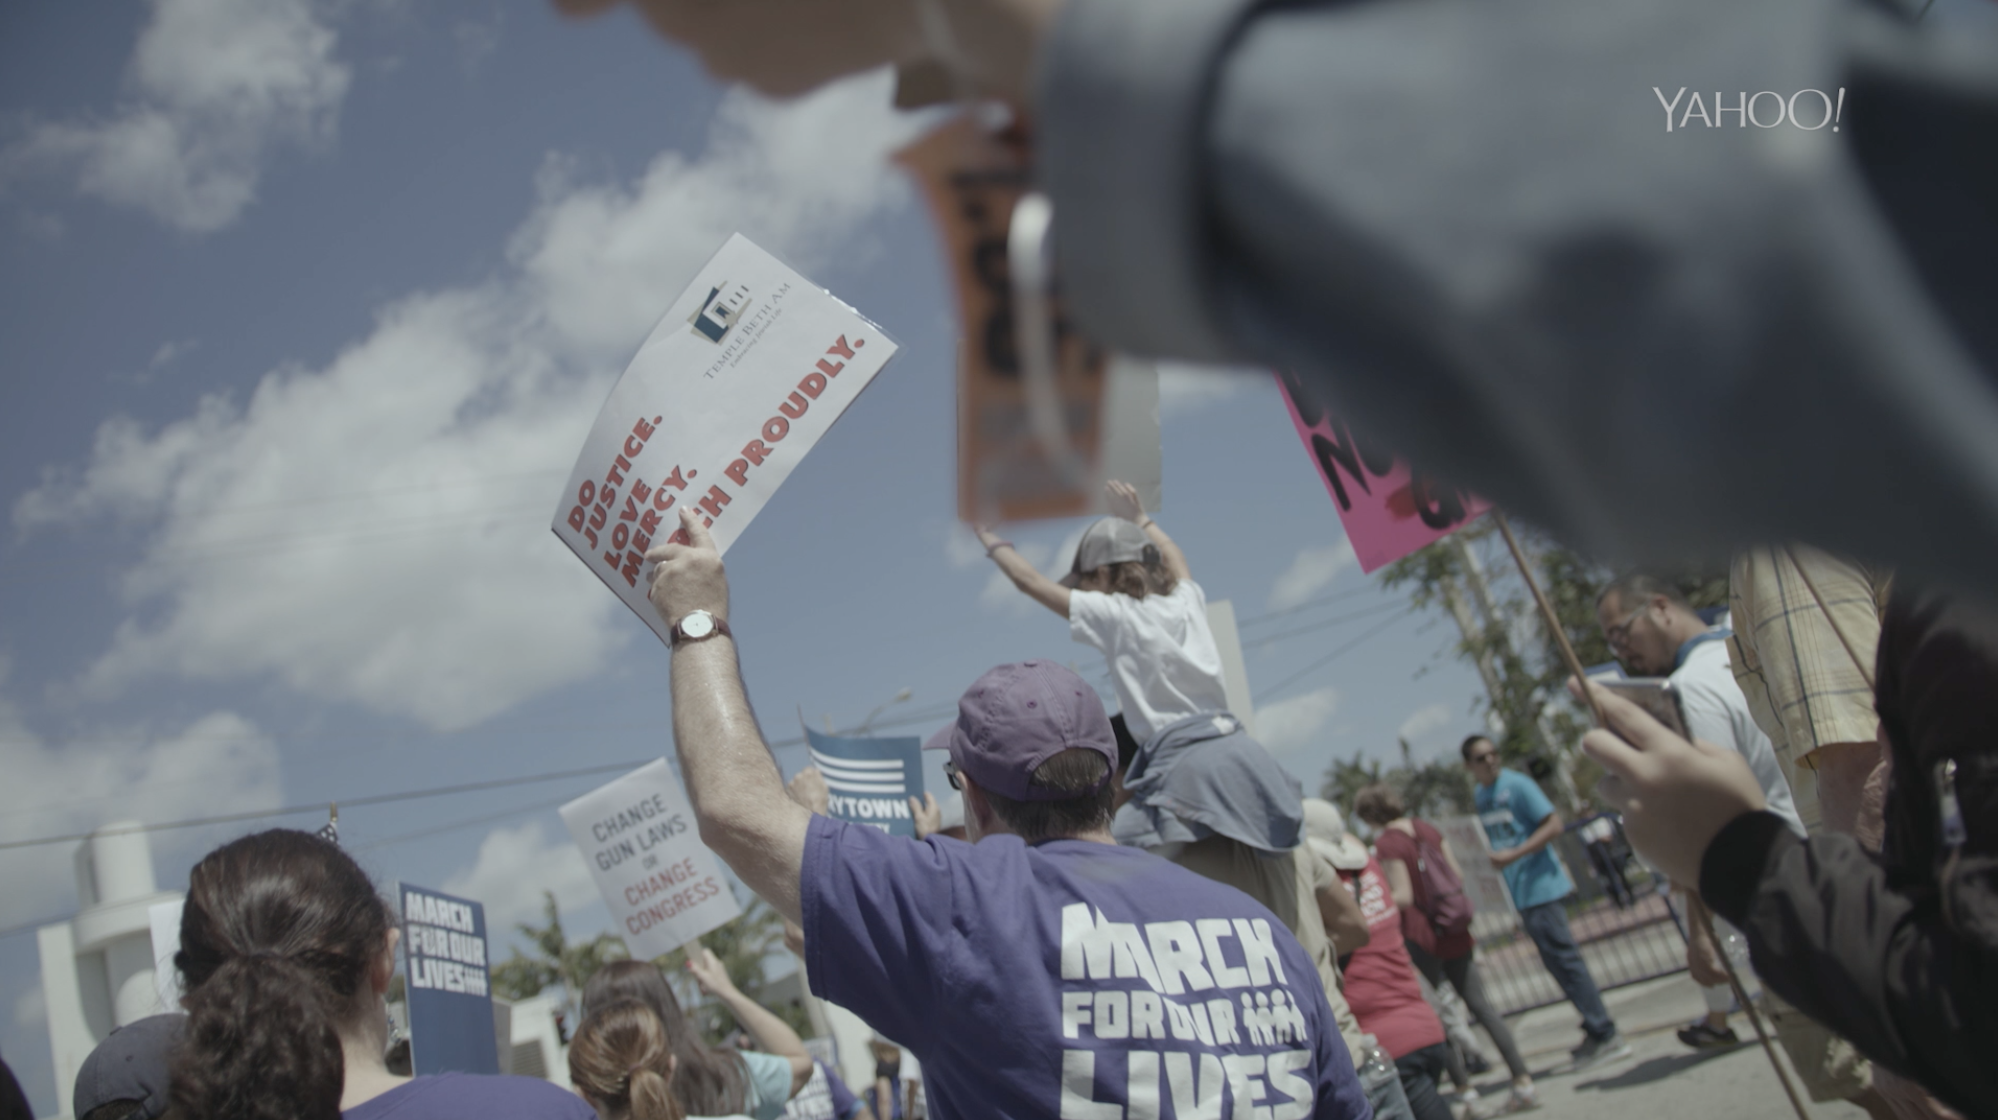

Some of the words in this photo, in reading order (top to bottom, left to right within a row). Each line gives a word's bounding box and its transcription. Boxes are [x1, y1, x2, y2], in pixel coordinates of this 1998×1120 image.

[703, 335, 745, 379] TEMPLE
[742, 304, 772, 336] BETH
[771, 282, 791, 304] AM
[723, 334, 865, 487] PROUDLY.
[567, 479, 596, 534] DO
[584, 415, 663, 551] JUSTICE.
[603, 478, 652, 571] LOVE
[621, 464, 698, 589] MERCY.
[591, 793, 667, 843] CHANGE
[595, 839, 635, 872] GUN
[635, 813, 687, 852] LAWS
[624, 857, 697, 906] CHANGE
[641, 853, 659, 870] OR
[405, 891, 475, 934] MARCH
[625, 876, 720, 935] CONGRESS
[407, 924, 450, 959] FOR
[449, 931, 487, 967] OUR
[410, 957, 466, 993] LIVES
[1061, 902, 1289, 995] MARCH
[1062, 990, 1166, 1040] FOR
[1162, 996, 1242, 1047] OUR
[1060, 1049, 1315, 1120] LIVES
